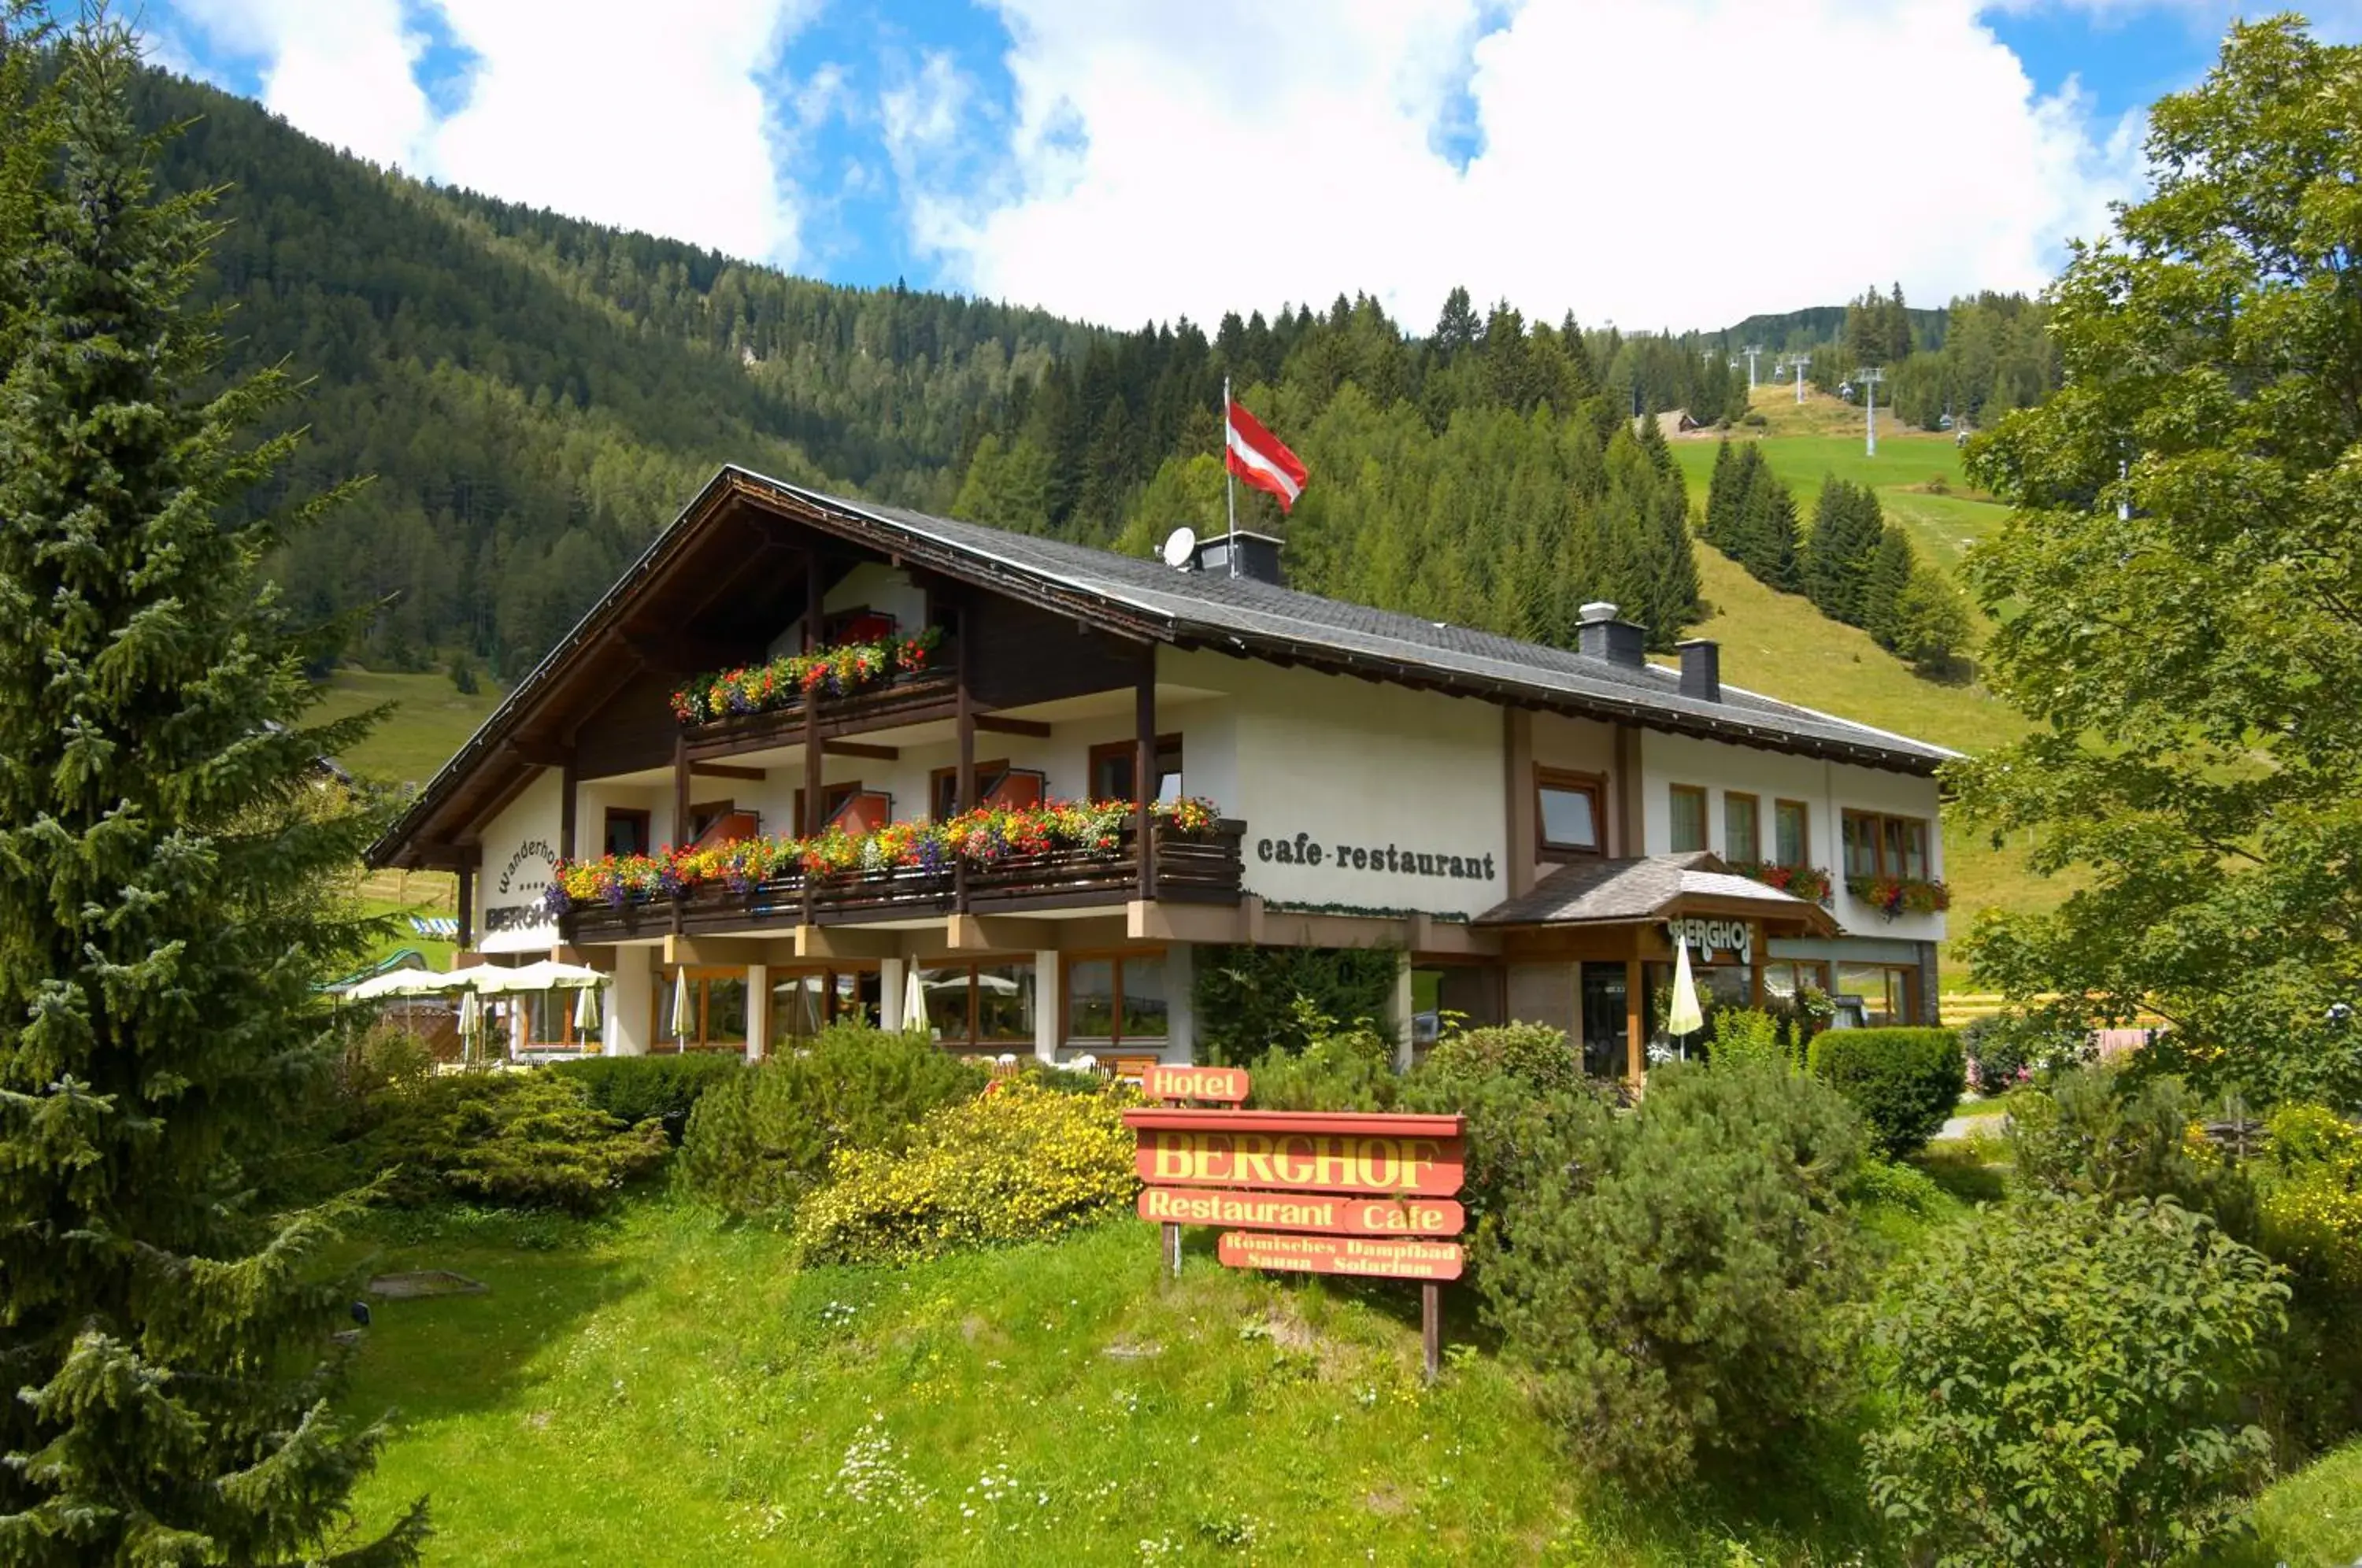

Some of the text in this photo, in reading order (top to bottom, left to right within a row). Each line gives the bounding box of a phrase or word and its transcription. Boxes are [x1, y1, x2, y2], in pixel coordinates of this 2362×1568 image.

[1668, 919, 1754, 964] BERGHOF
[1153, 1071, 1237, 1097] Hotel
[1153, 1131, 1442, 1189] BERGHOF
[1148, 1191, 1443, 1231] Restaurant Cafe
[1226, 1234, 1456, 1260] Römisches Dampfbad
[1248, 1252, 1433, 1276] Sauna Solarium
